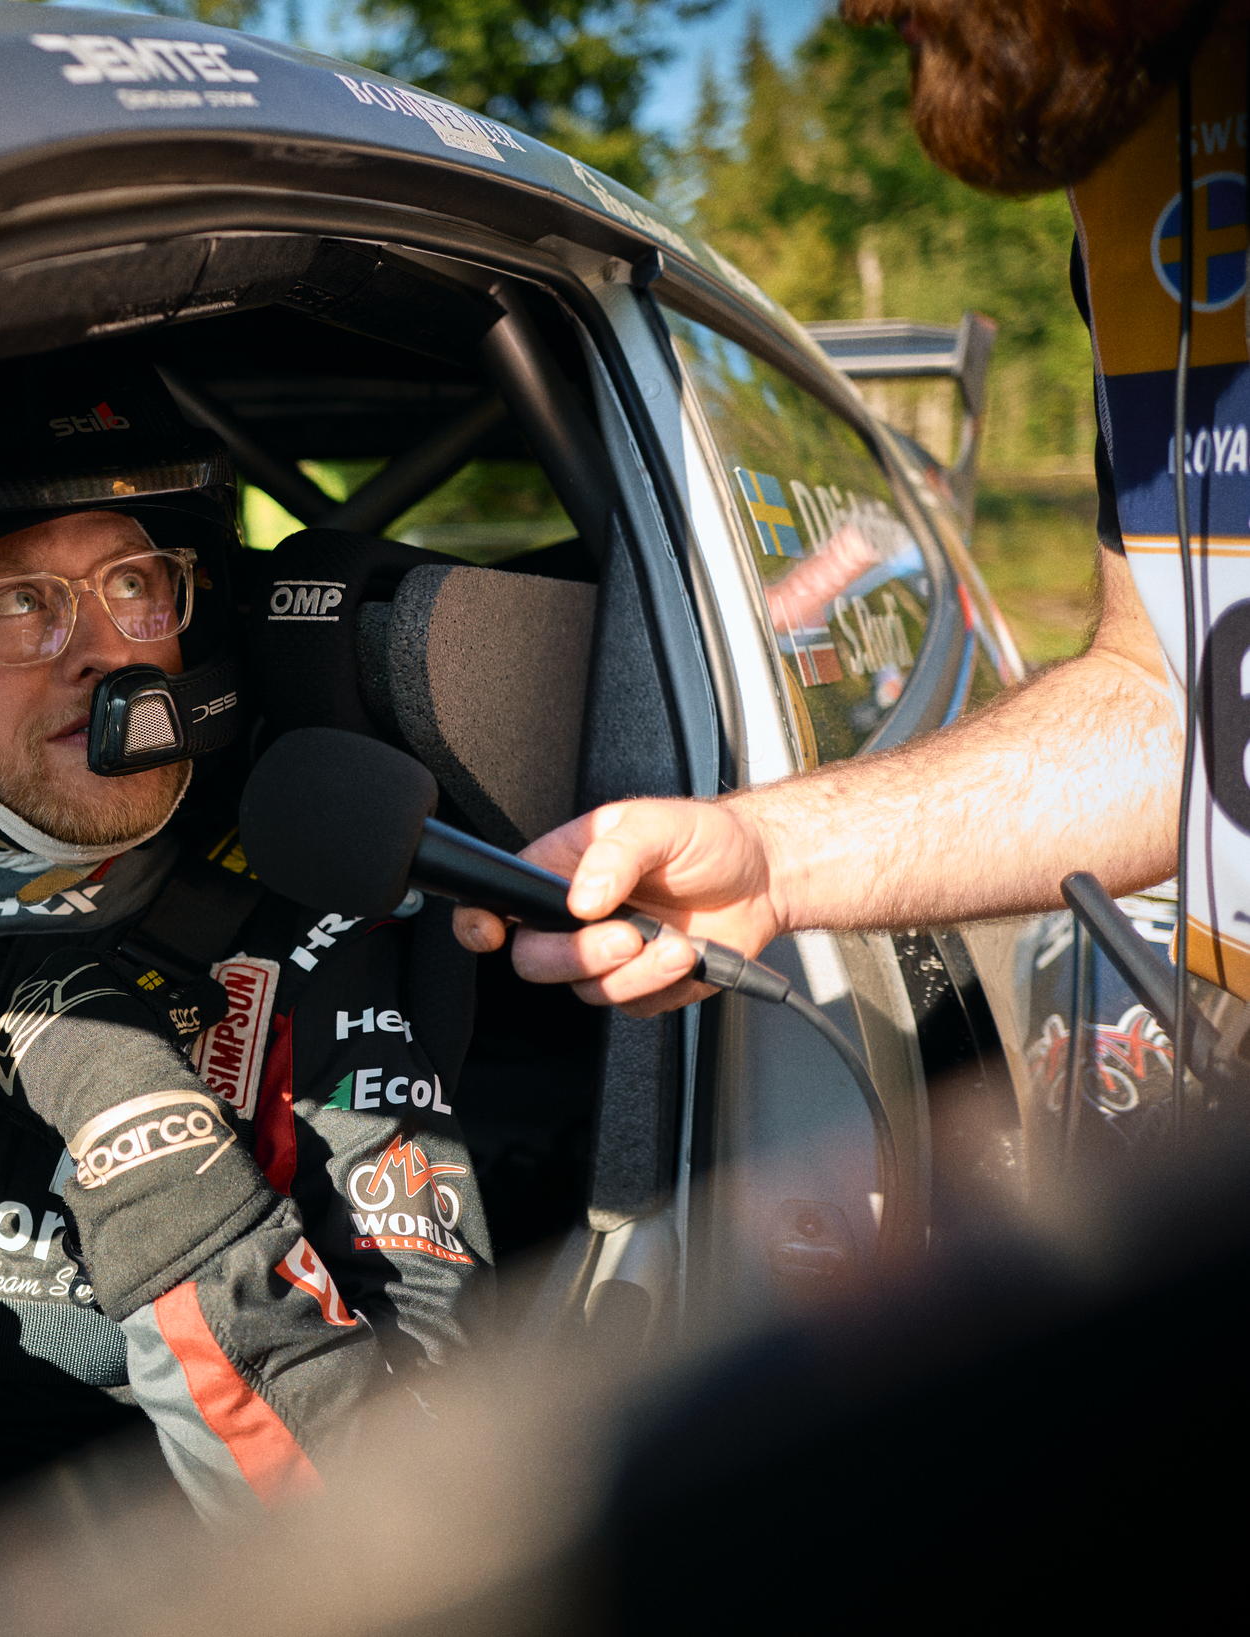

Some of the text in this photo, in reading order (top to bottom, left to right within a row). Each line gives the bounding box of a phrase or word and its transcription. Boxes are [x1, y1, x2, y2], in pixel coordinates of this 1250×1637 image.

[334, 72, 526, 153] BONNEVIER
[269, 586, 343, 615] OMP
[288, 913, 367, 973] HR
[206, 972, 257, 1101] SIMPSON
[352, 1212, 464, 1254] WORLD
[361, 1237, 469, 1263] COLLECTION
